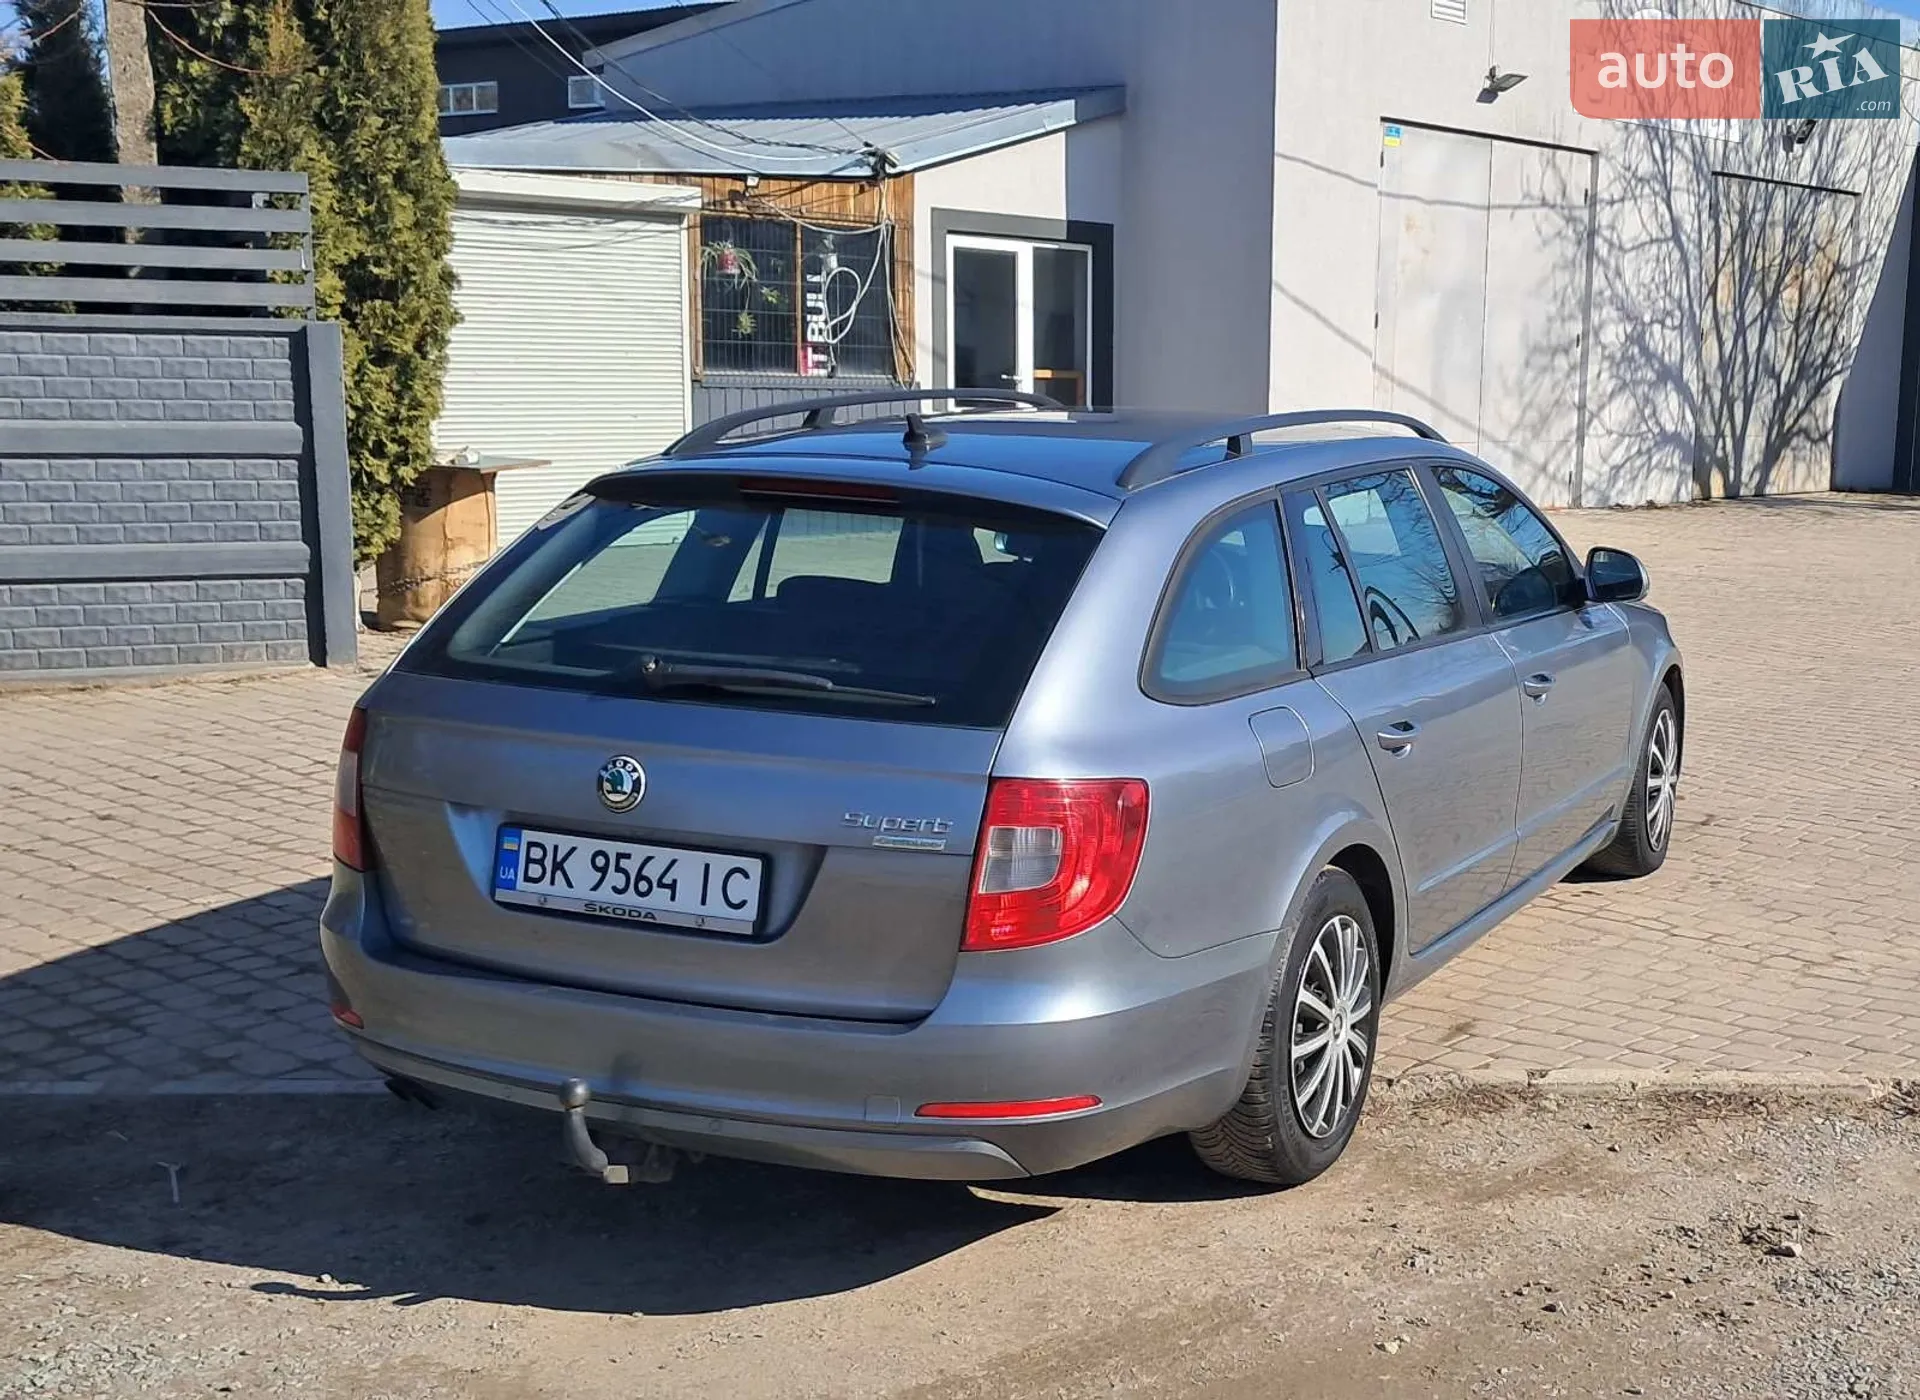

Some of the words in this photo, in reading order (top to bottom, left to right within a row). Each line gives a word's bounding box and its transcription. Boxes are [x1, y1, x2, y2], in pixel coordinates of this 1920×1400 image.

[499, 868, 516, 881] UA
[523, 841, 578, 889] BK
[589, 849, 679, 902] 9564
[700, 863, 750, 910] IC
